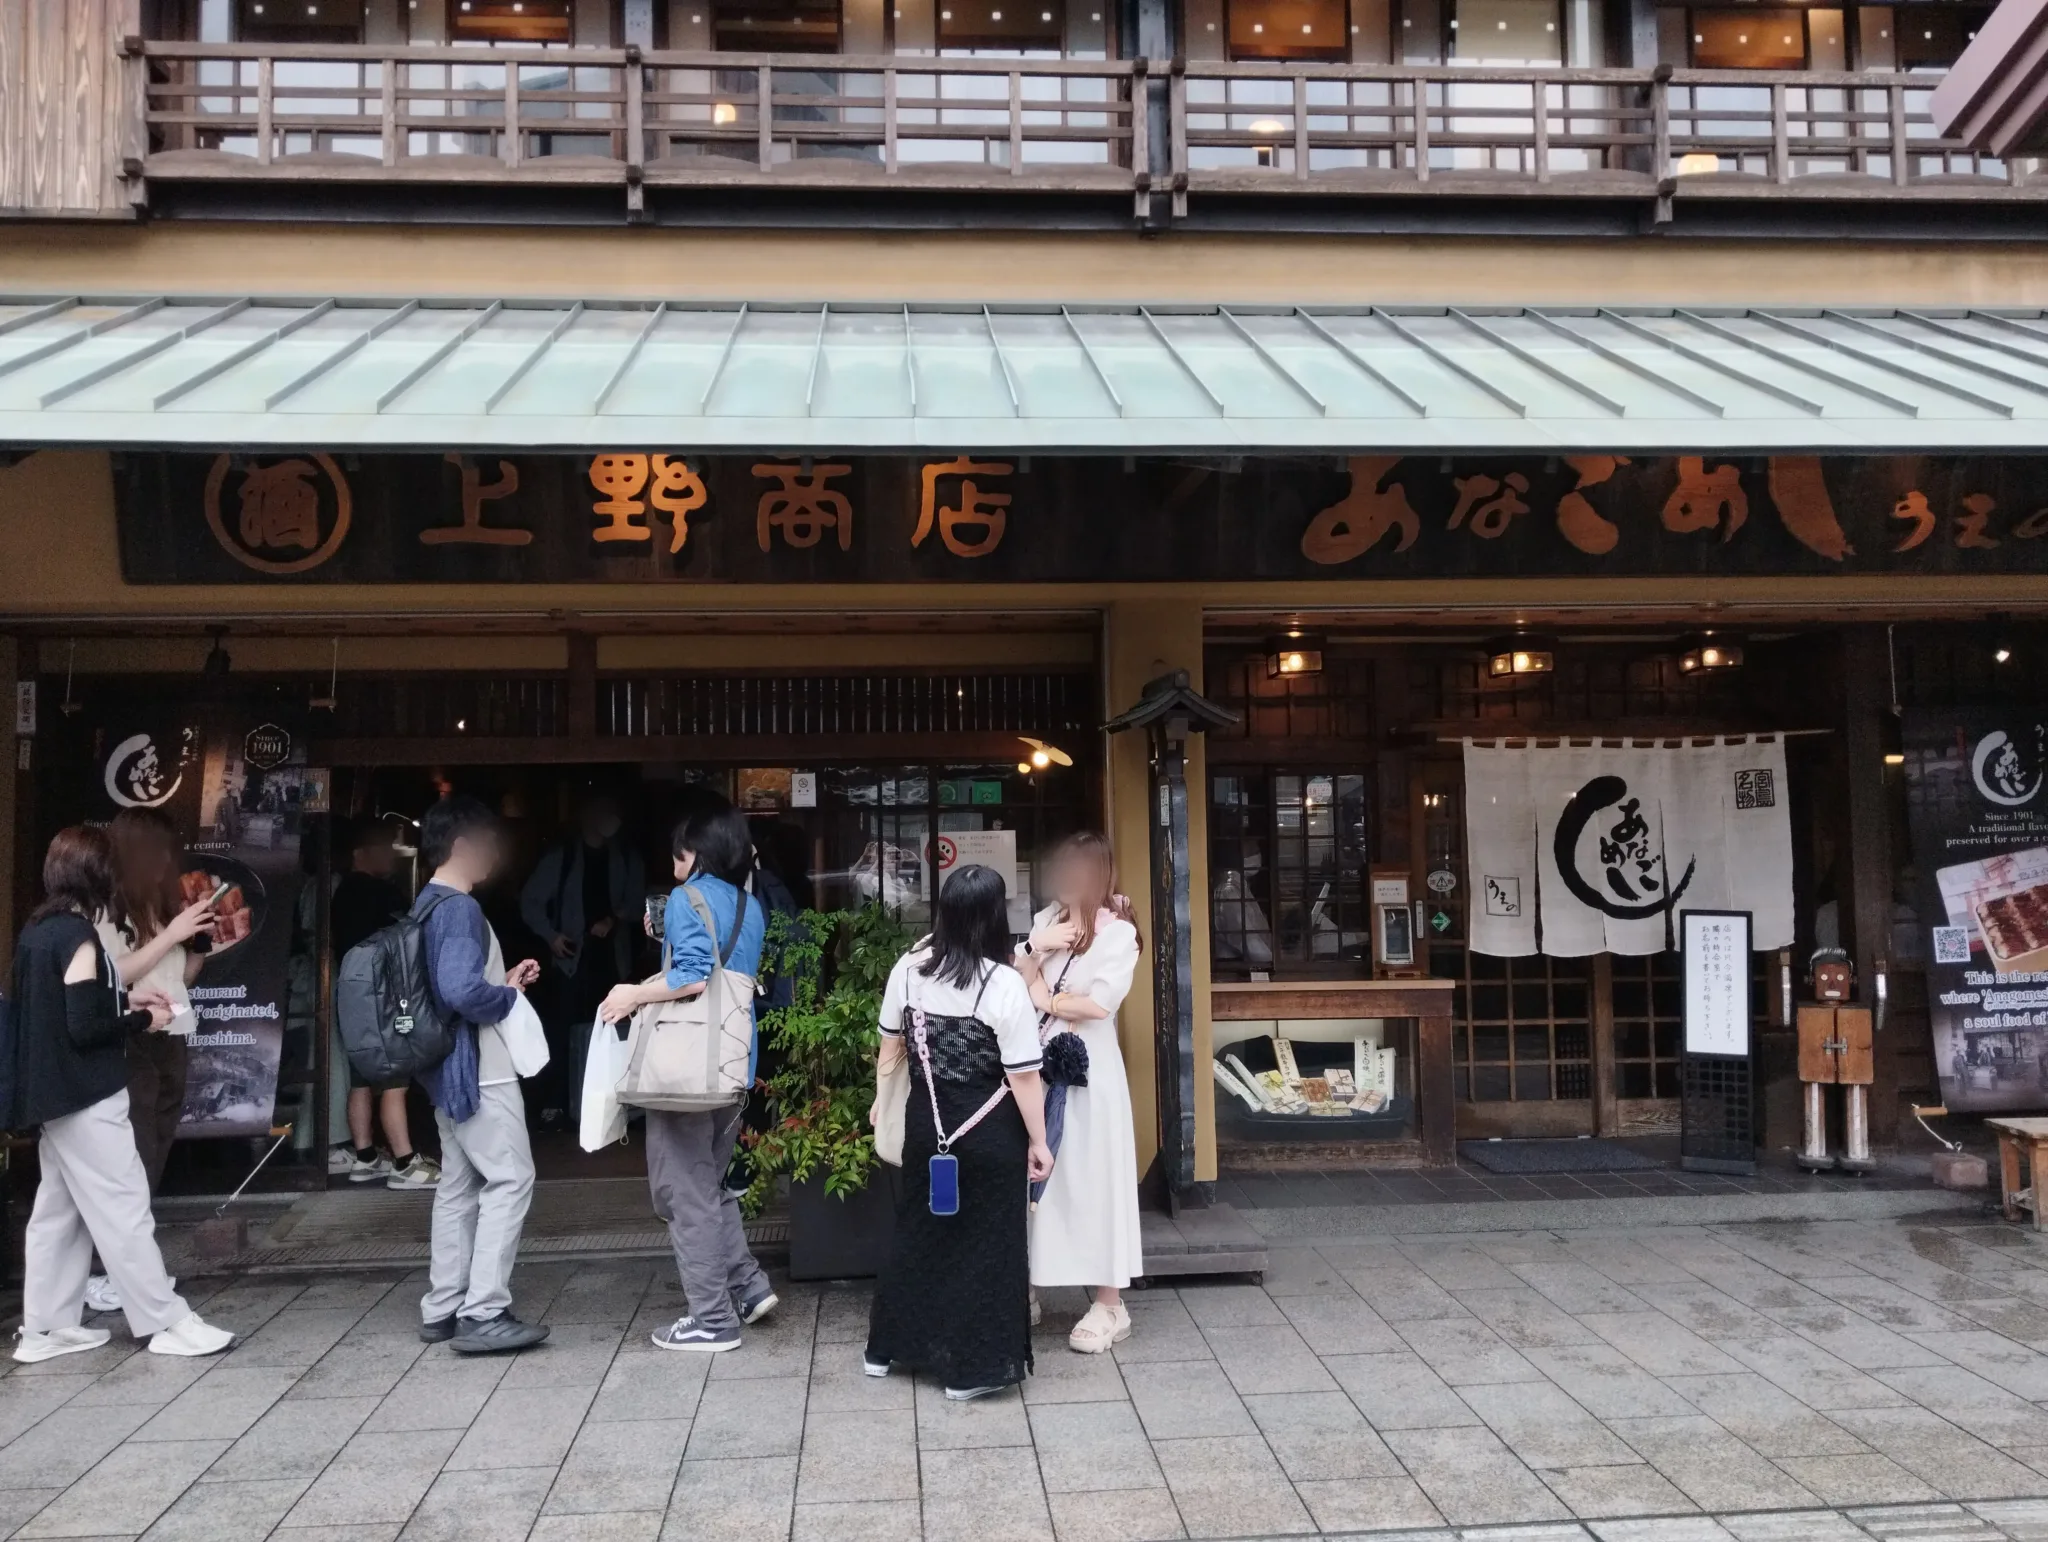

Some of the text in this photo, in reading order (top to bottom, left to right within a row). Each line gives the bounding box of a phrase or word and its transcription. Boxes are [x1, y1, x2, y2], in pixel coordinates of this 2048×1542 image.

[253, 742, 283, 754] 1901
[1985, 811, 2033, 821] Since 1901
[1969, 825, 1975, 833] A
[1978, 823, 2025, 833] traditional
[194, 842, 236, 852] century.
[1946, 835, 1991, 848] preserved
[1995, 834, 2008, 843] for
[1965, 971, 1995, 985] This
[1996, 971, 2009, 984] is
[2010, 970, 2031, 983] the
[1940, 991, 1980, 1005] where
[202, 1002, 279, 1020] originated,
[1964, 1011, 2047, 1028] a soul food of
